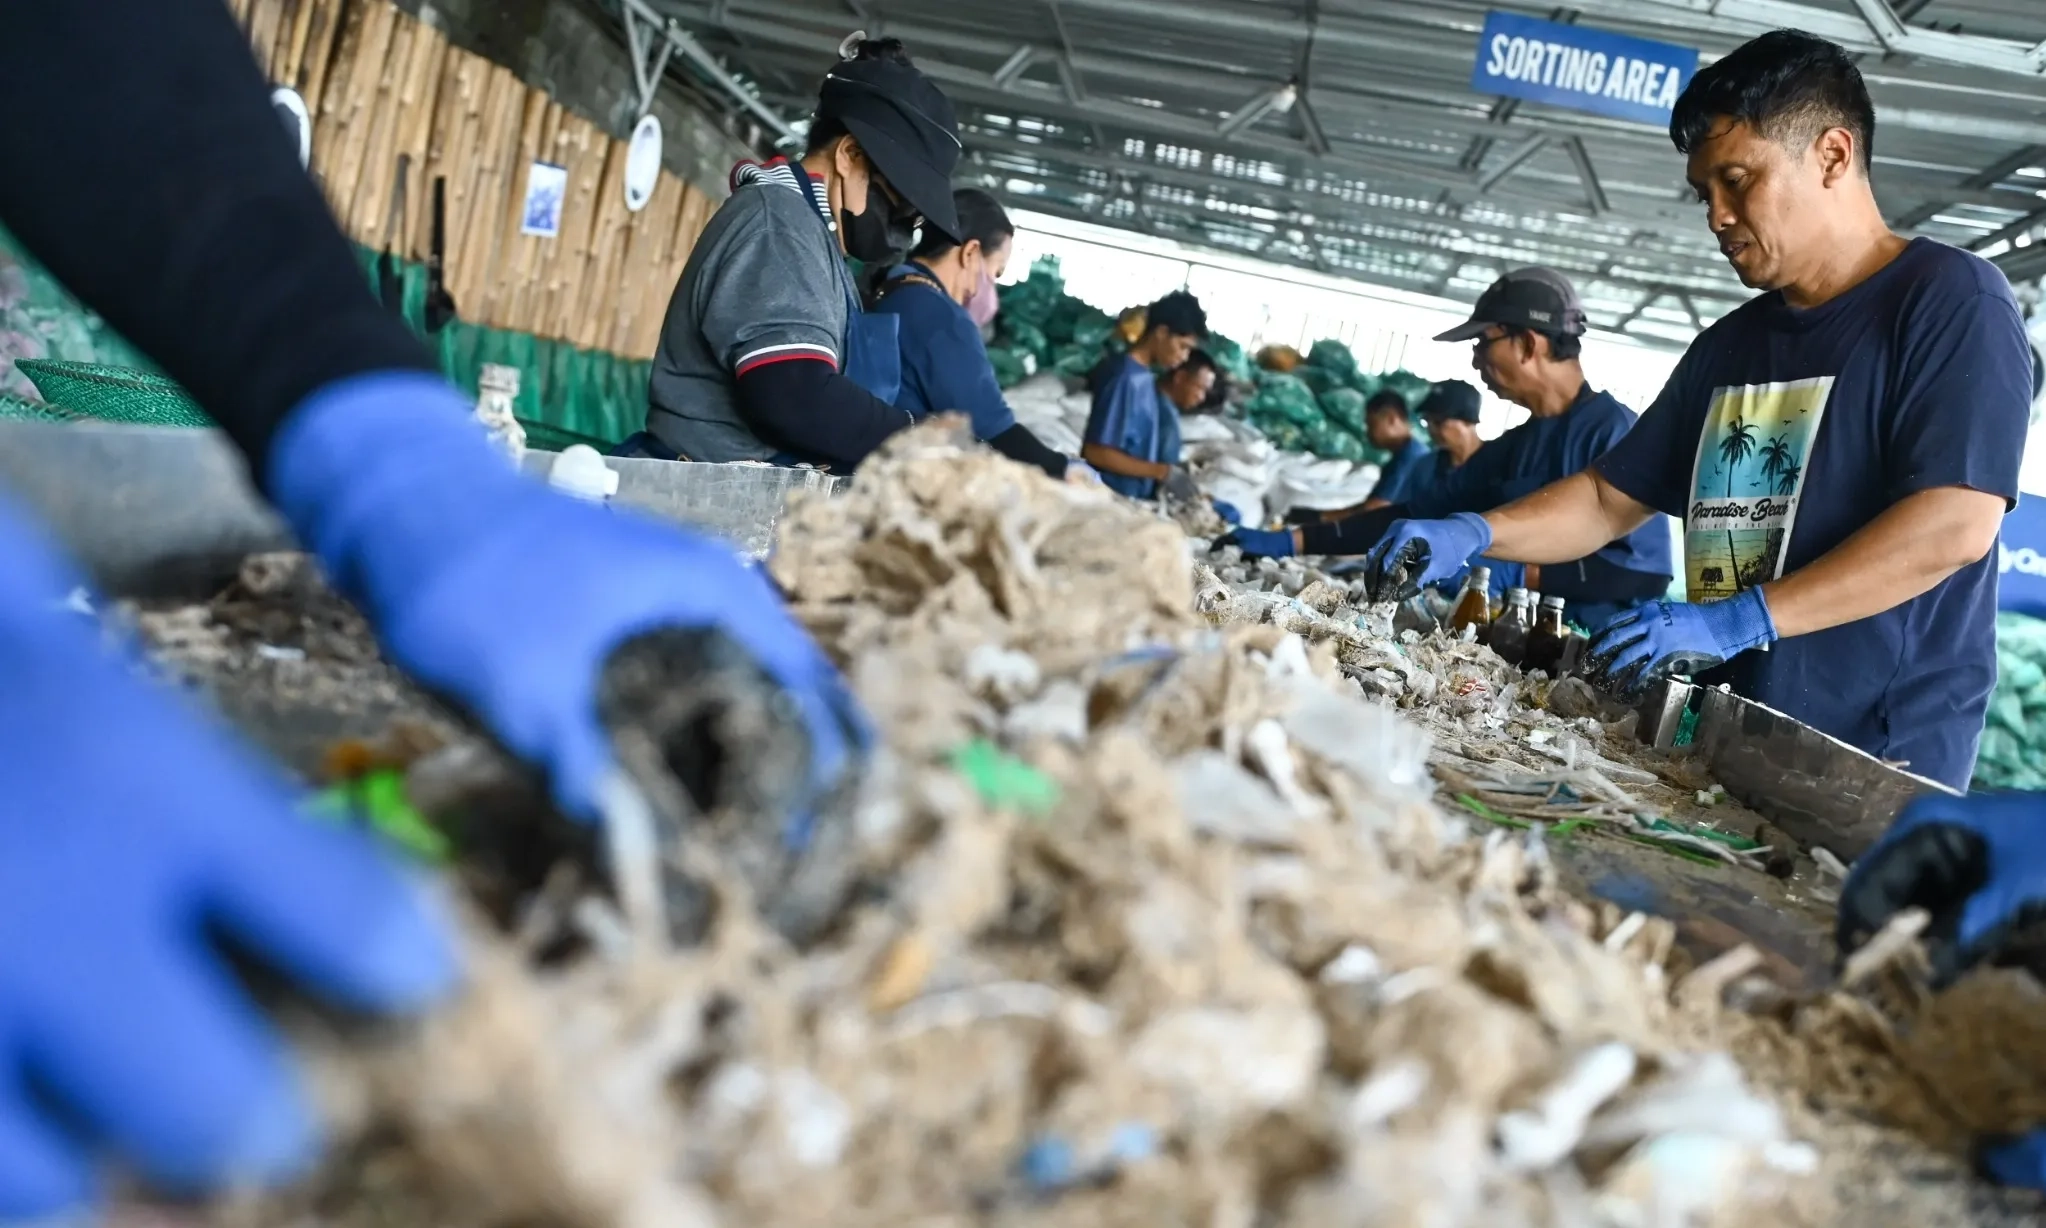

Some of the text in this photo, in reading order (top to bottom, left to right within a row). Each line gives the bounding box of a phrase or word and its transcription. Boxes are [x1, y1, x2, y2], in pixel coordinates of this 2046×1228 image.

[1486, 33, 1680, 110] SORTING AREA
[1691, 502, 1749, 523] Paradise
